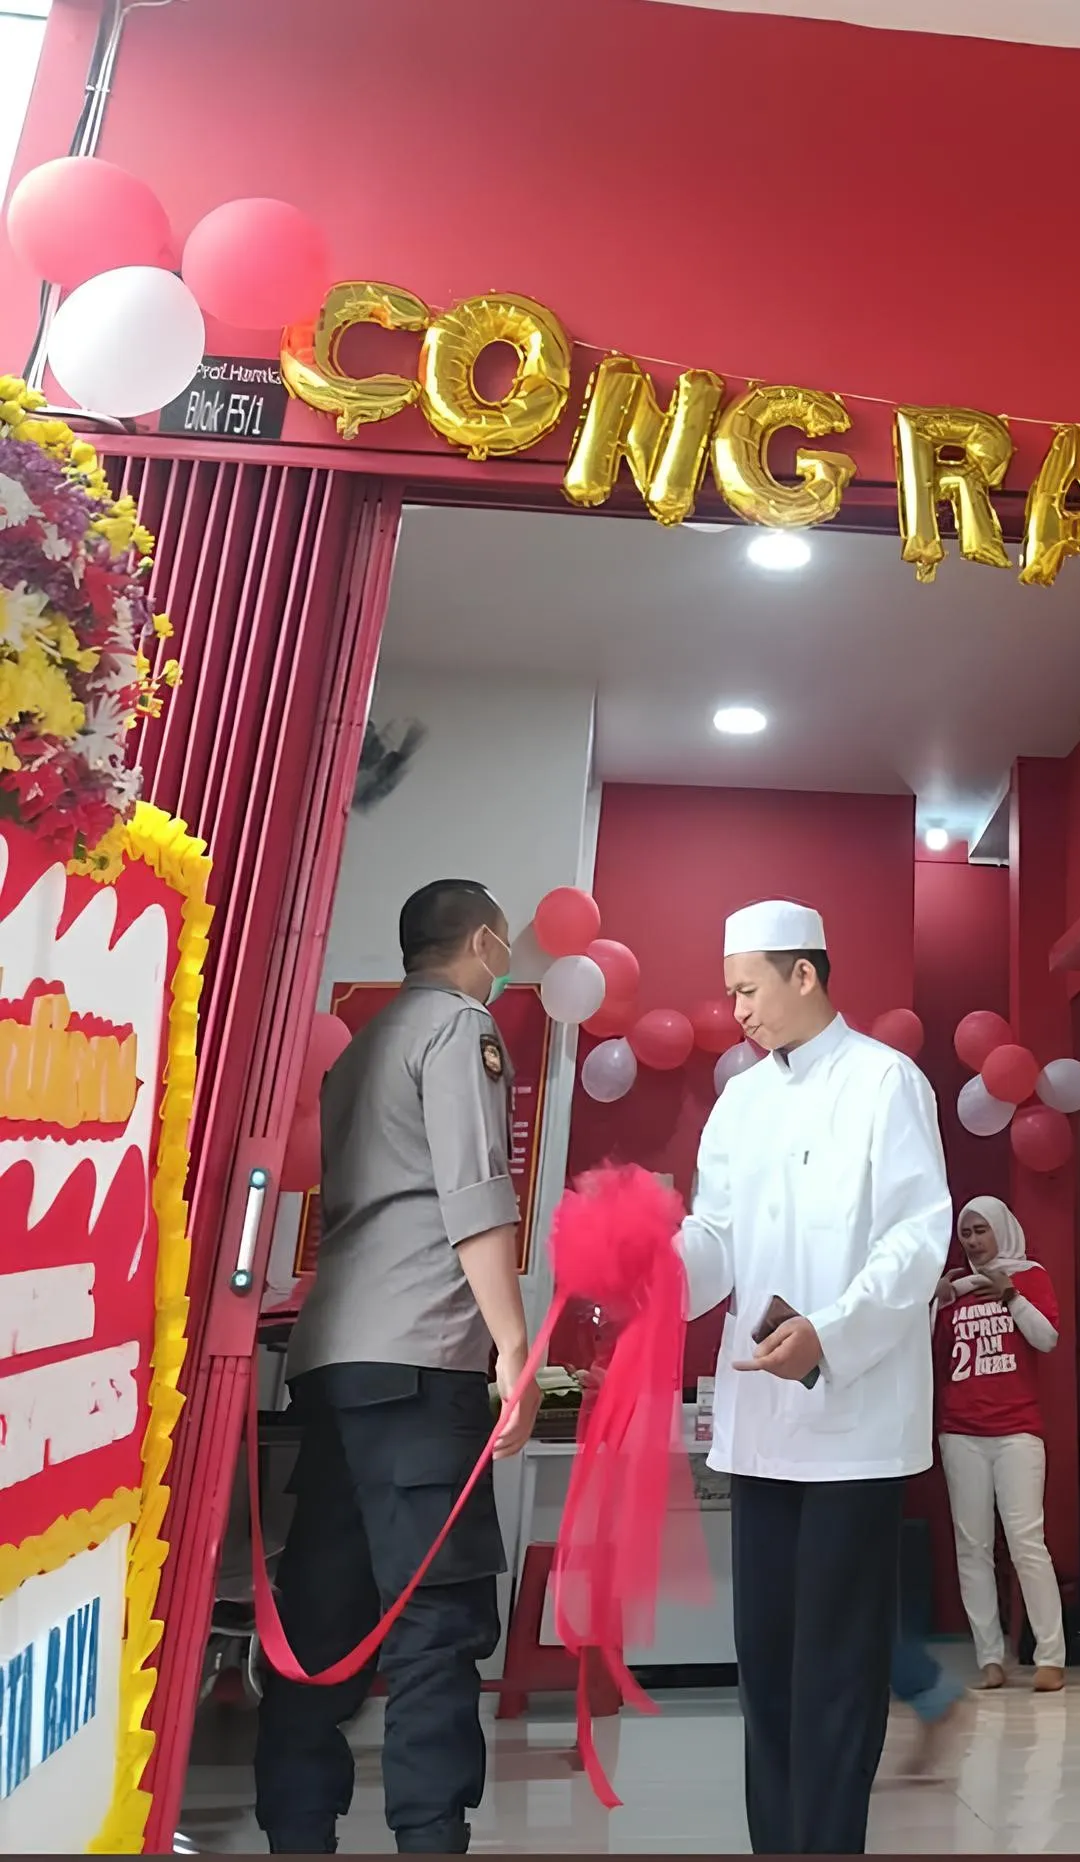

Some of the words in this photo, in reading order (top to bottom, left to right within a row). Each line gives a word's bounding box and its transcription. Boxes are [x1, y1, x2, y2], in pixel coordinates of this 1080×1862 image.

[184, 390, 224, 432] Blok
[224, 393, 263, 435] F5/1
[952, 1341, 972, 1382] 2
